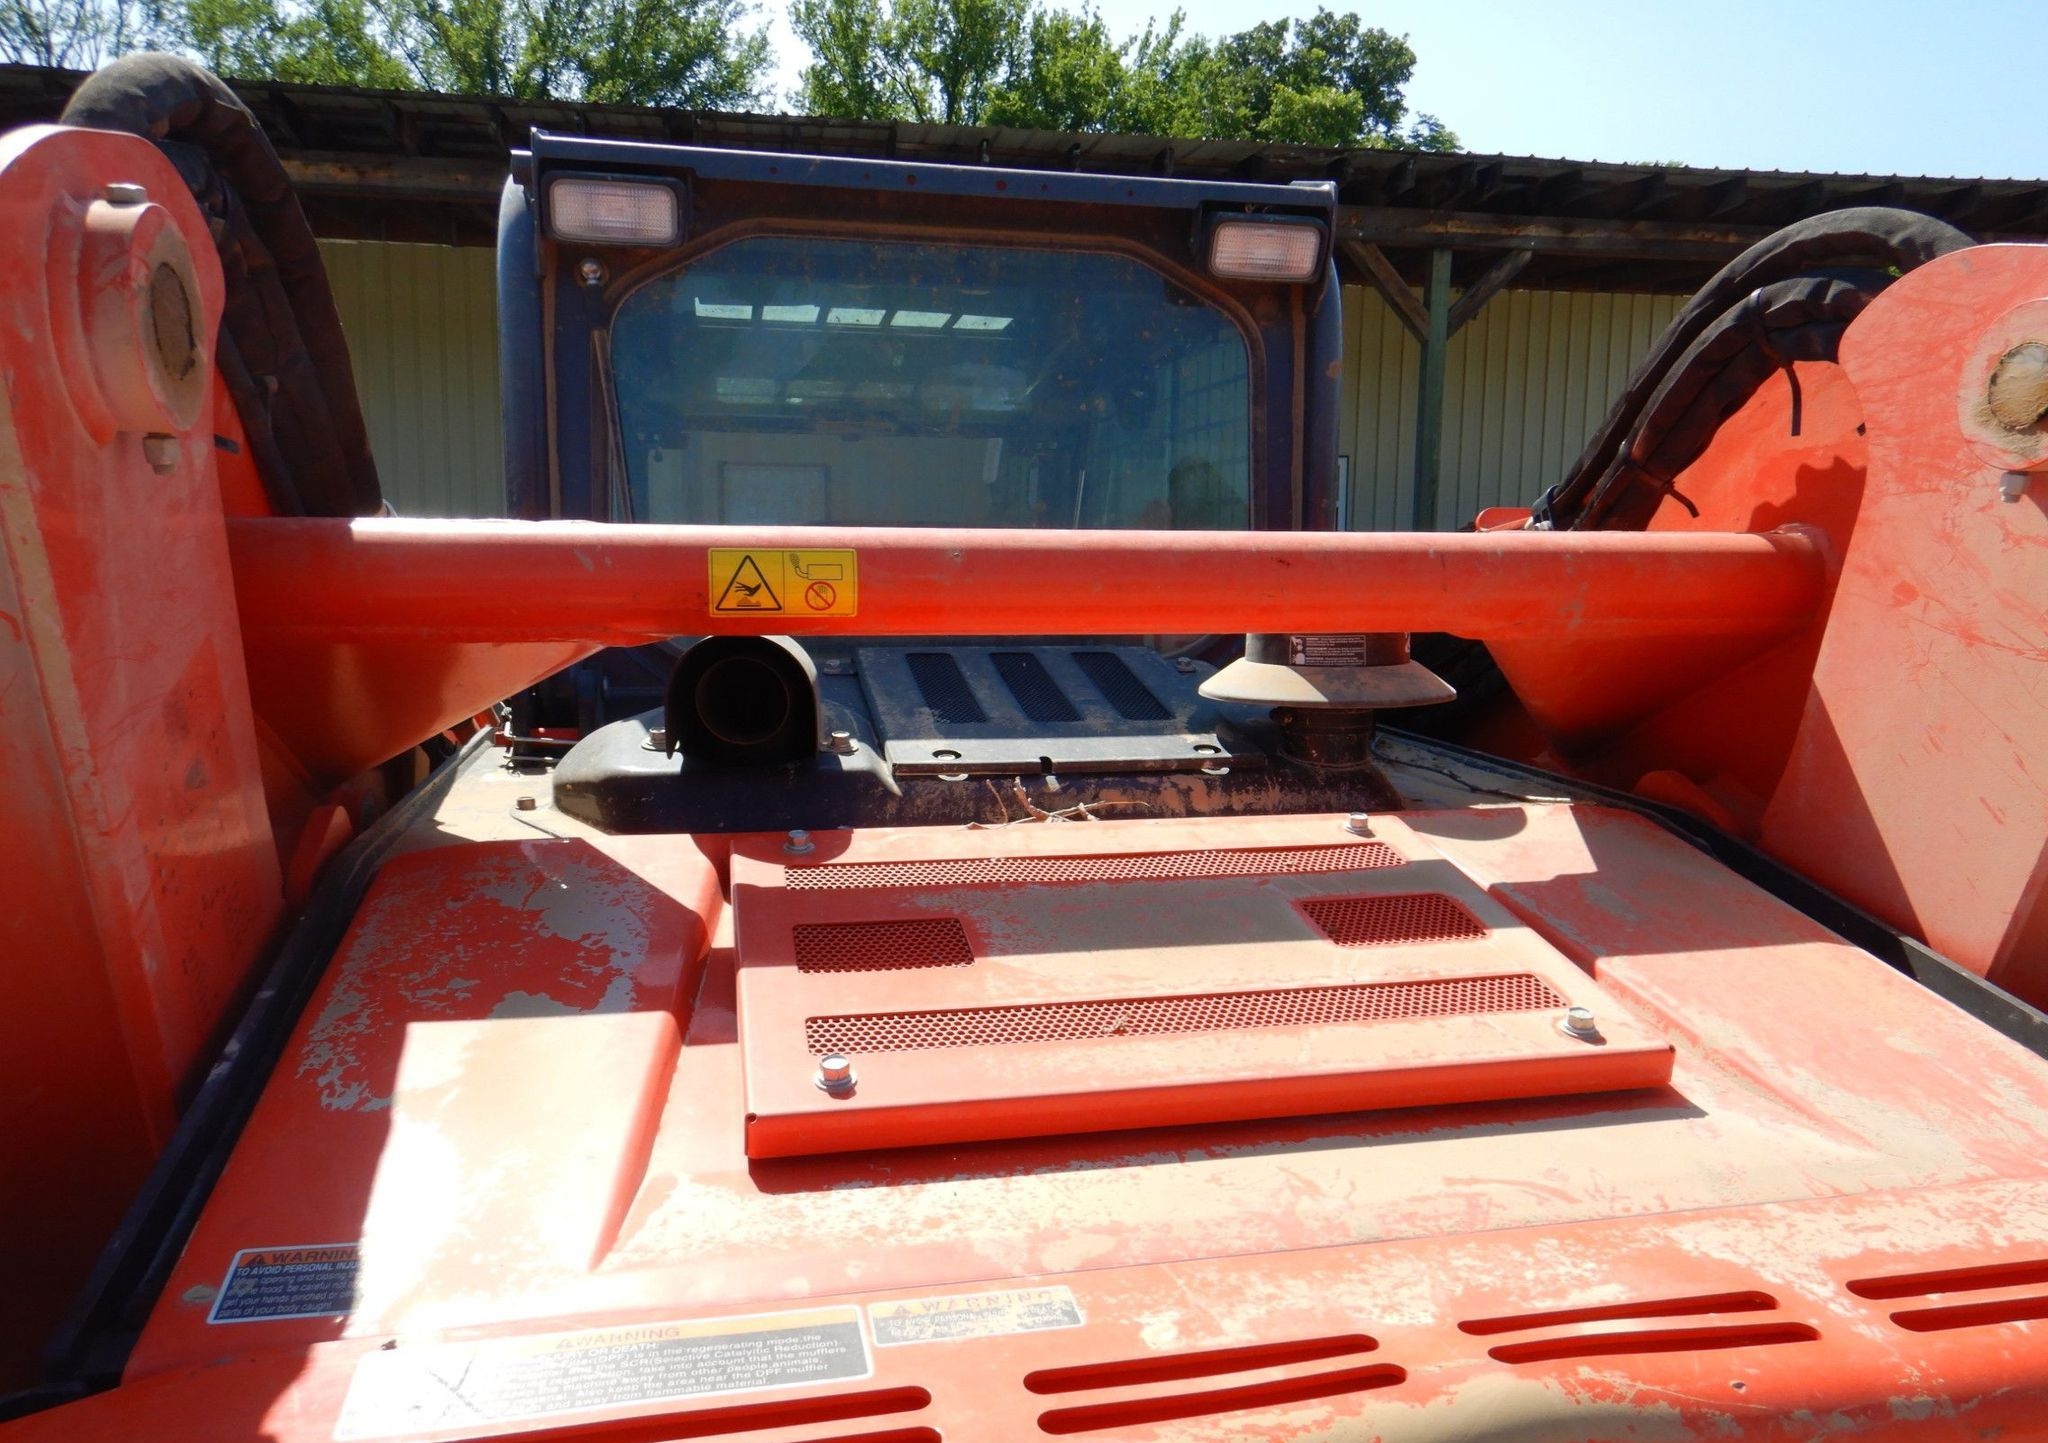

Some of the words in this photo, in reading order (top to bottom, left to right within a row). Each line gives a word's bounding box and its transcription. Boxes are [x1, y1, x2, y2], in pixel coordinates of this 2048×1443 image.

[271, 1249, 358, 1263] WARNIN
[236, 1267, 250, 1276] TO
[250, 1265, 282, 1275] AVOID
[283, 1263, 334, 1273] PERSONAL
[336, 1261, 358, 1270] INJU
[576, 1327, 680, 1346] WARNING
[648, 1350, 660, 1358] in
[663, 1347, 683, 1356] the
[687, 1340, 763, 1354] regenerating
[670, 1361, 693, 1370] into
[697, 1357, 745, 1369] account
[749, 1353, 772, 1363] that
[775, 1351, 795, 1360] the
[798, 1346, 847, 1358] mufflers
[643, 1381, 663, 1390] the
[667, 1377, 696, 1387] area
[700, 1373, 728, 1383] near
[731, 1370, 751, 1380] the
[755, 1366, 782, 1378] DPF
[786, 1362, 829, 1374] muffler
[659, 1370, 687, 1379] from
[691, 1366, 723, 1376] other
